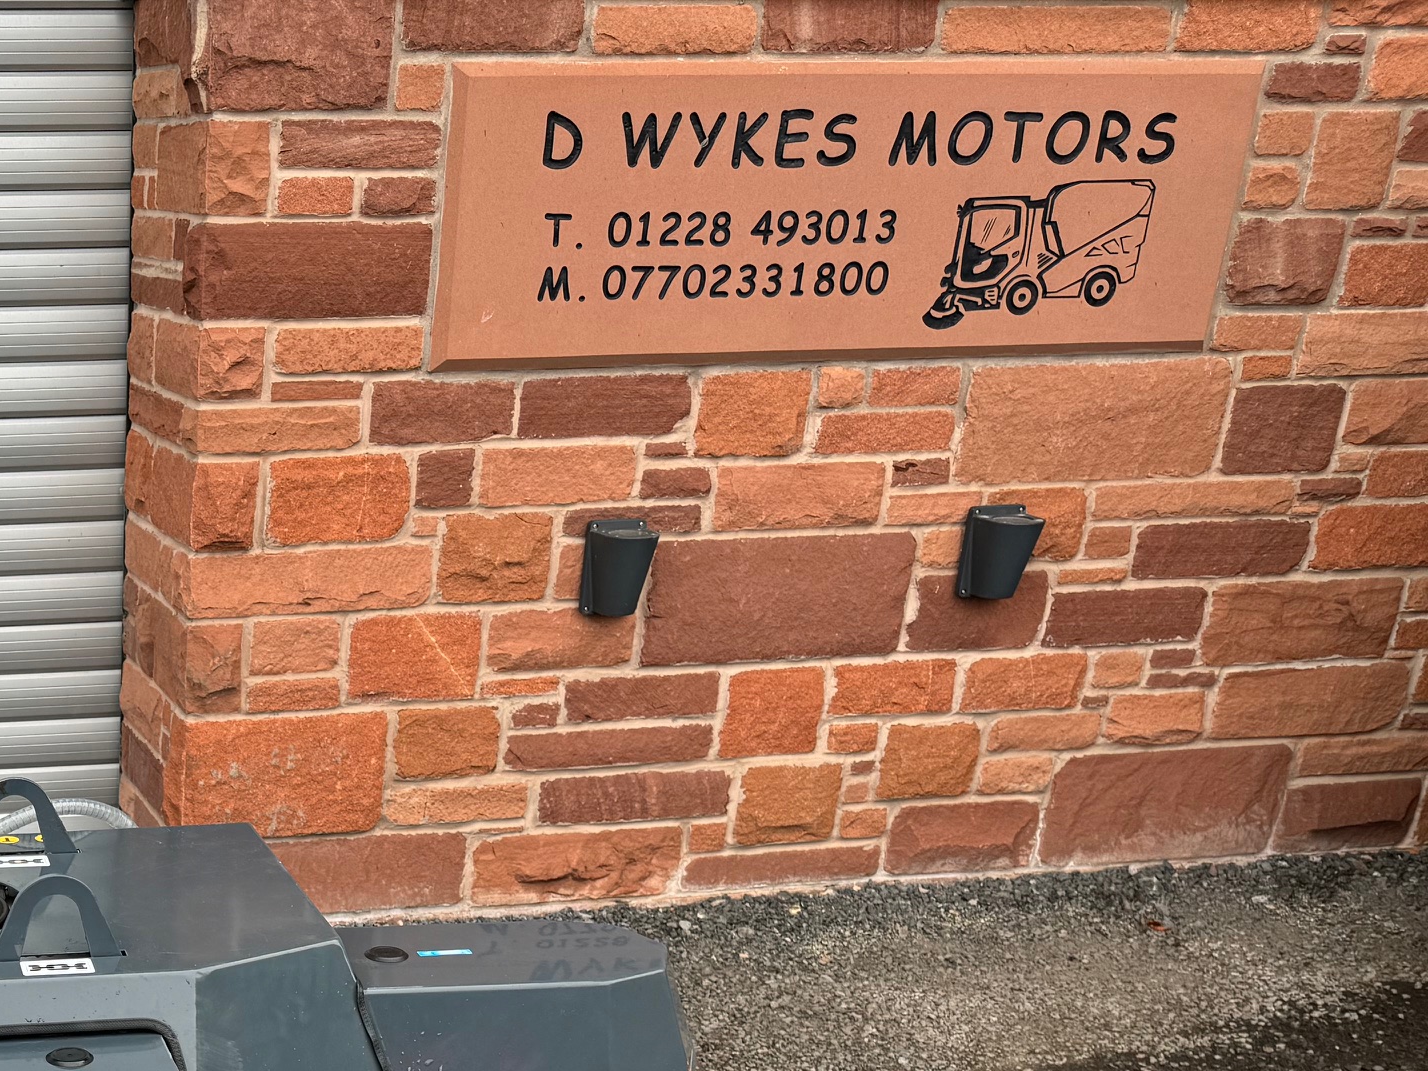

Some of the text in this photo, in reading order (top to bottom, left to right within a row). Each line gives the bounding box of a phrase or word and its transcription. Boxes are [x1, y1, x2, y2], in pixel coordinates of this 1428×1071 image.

[542, 108, 1178, 170] D WYKES MOTORS
[544, 208, 897, 250] T. 01228 493013
[537, 260, 889, 302] M. 07702331800
